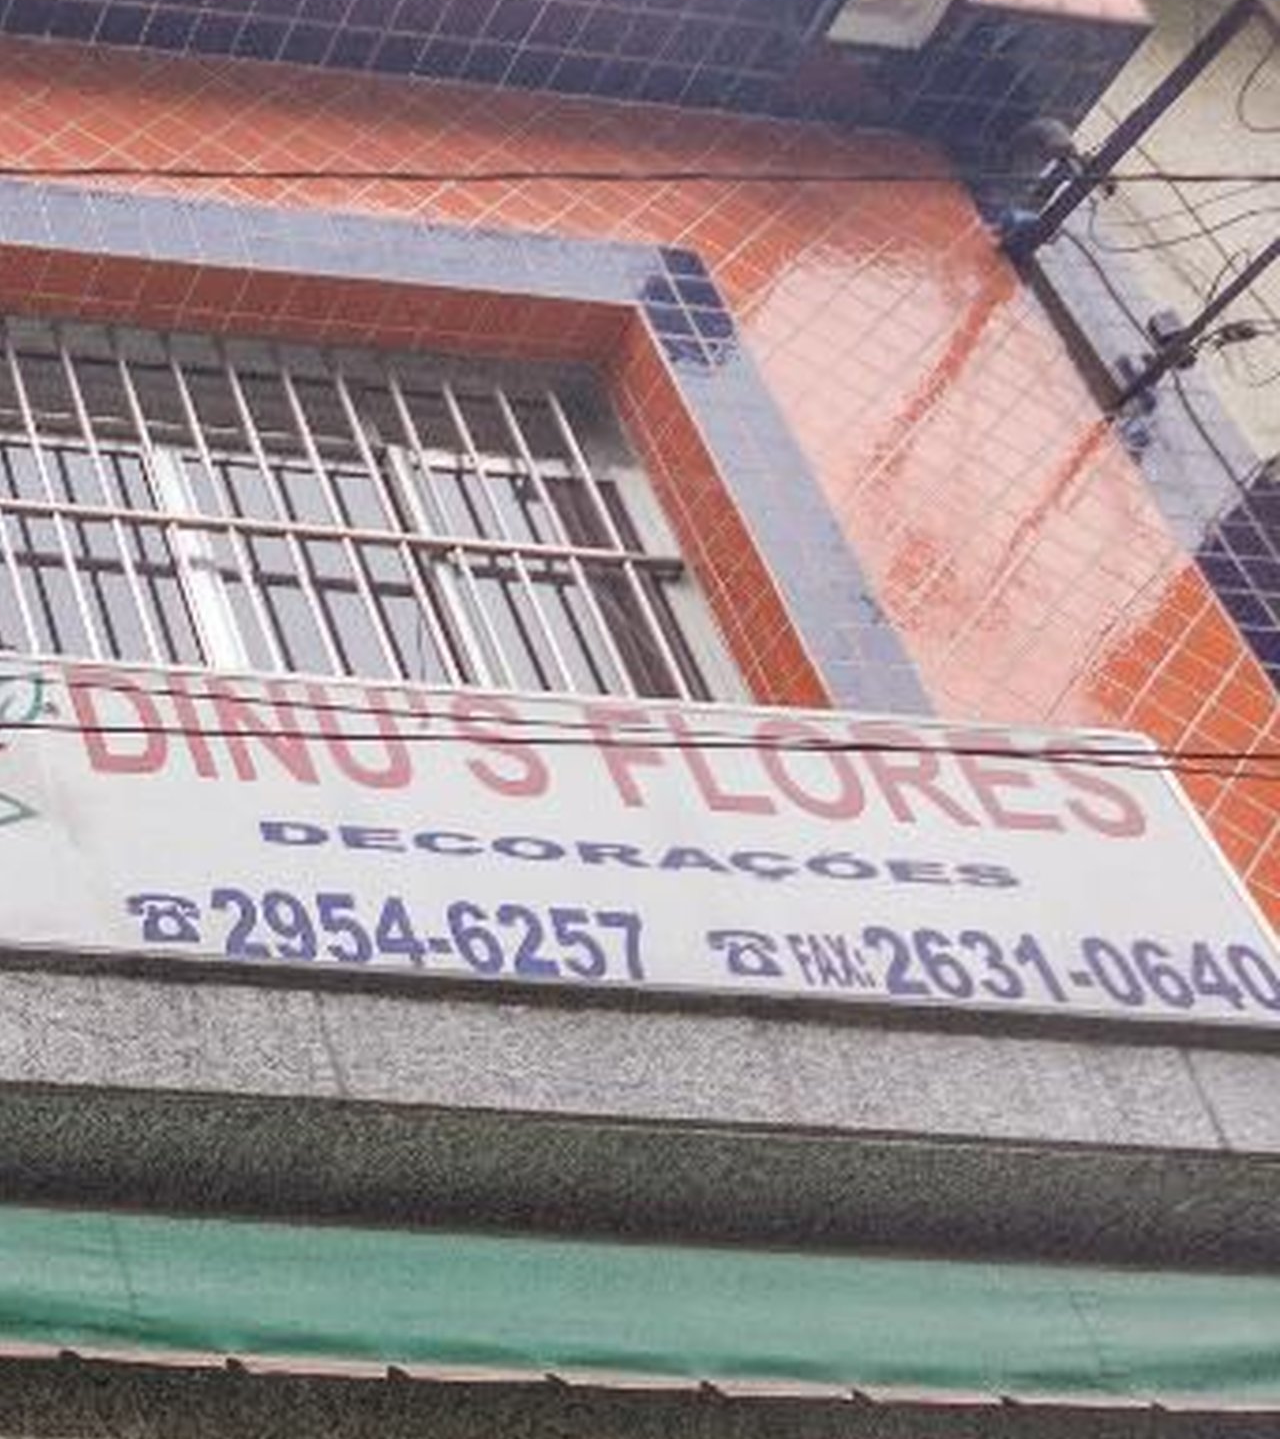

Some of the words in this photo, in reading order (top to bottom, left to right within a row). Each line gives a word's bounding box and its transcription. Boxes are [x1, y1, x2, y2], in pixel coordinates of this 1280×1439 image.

[62, 665, 550, 798] DINU'S
[582, 703, 1147, 839] FLORES
[210, 887, 645, 981] 2954-6257
[862, 925, 1280, 1011] 2631-0640
